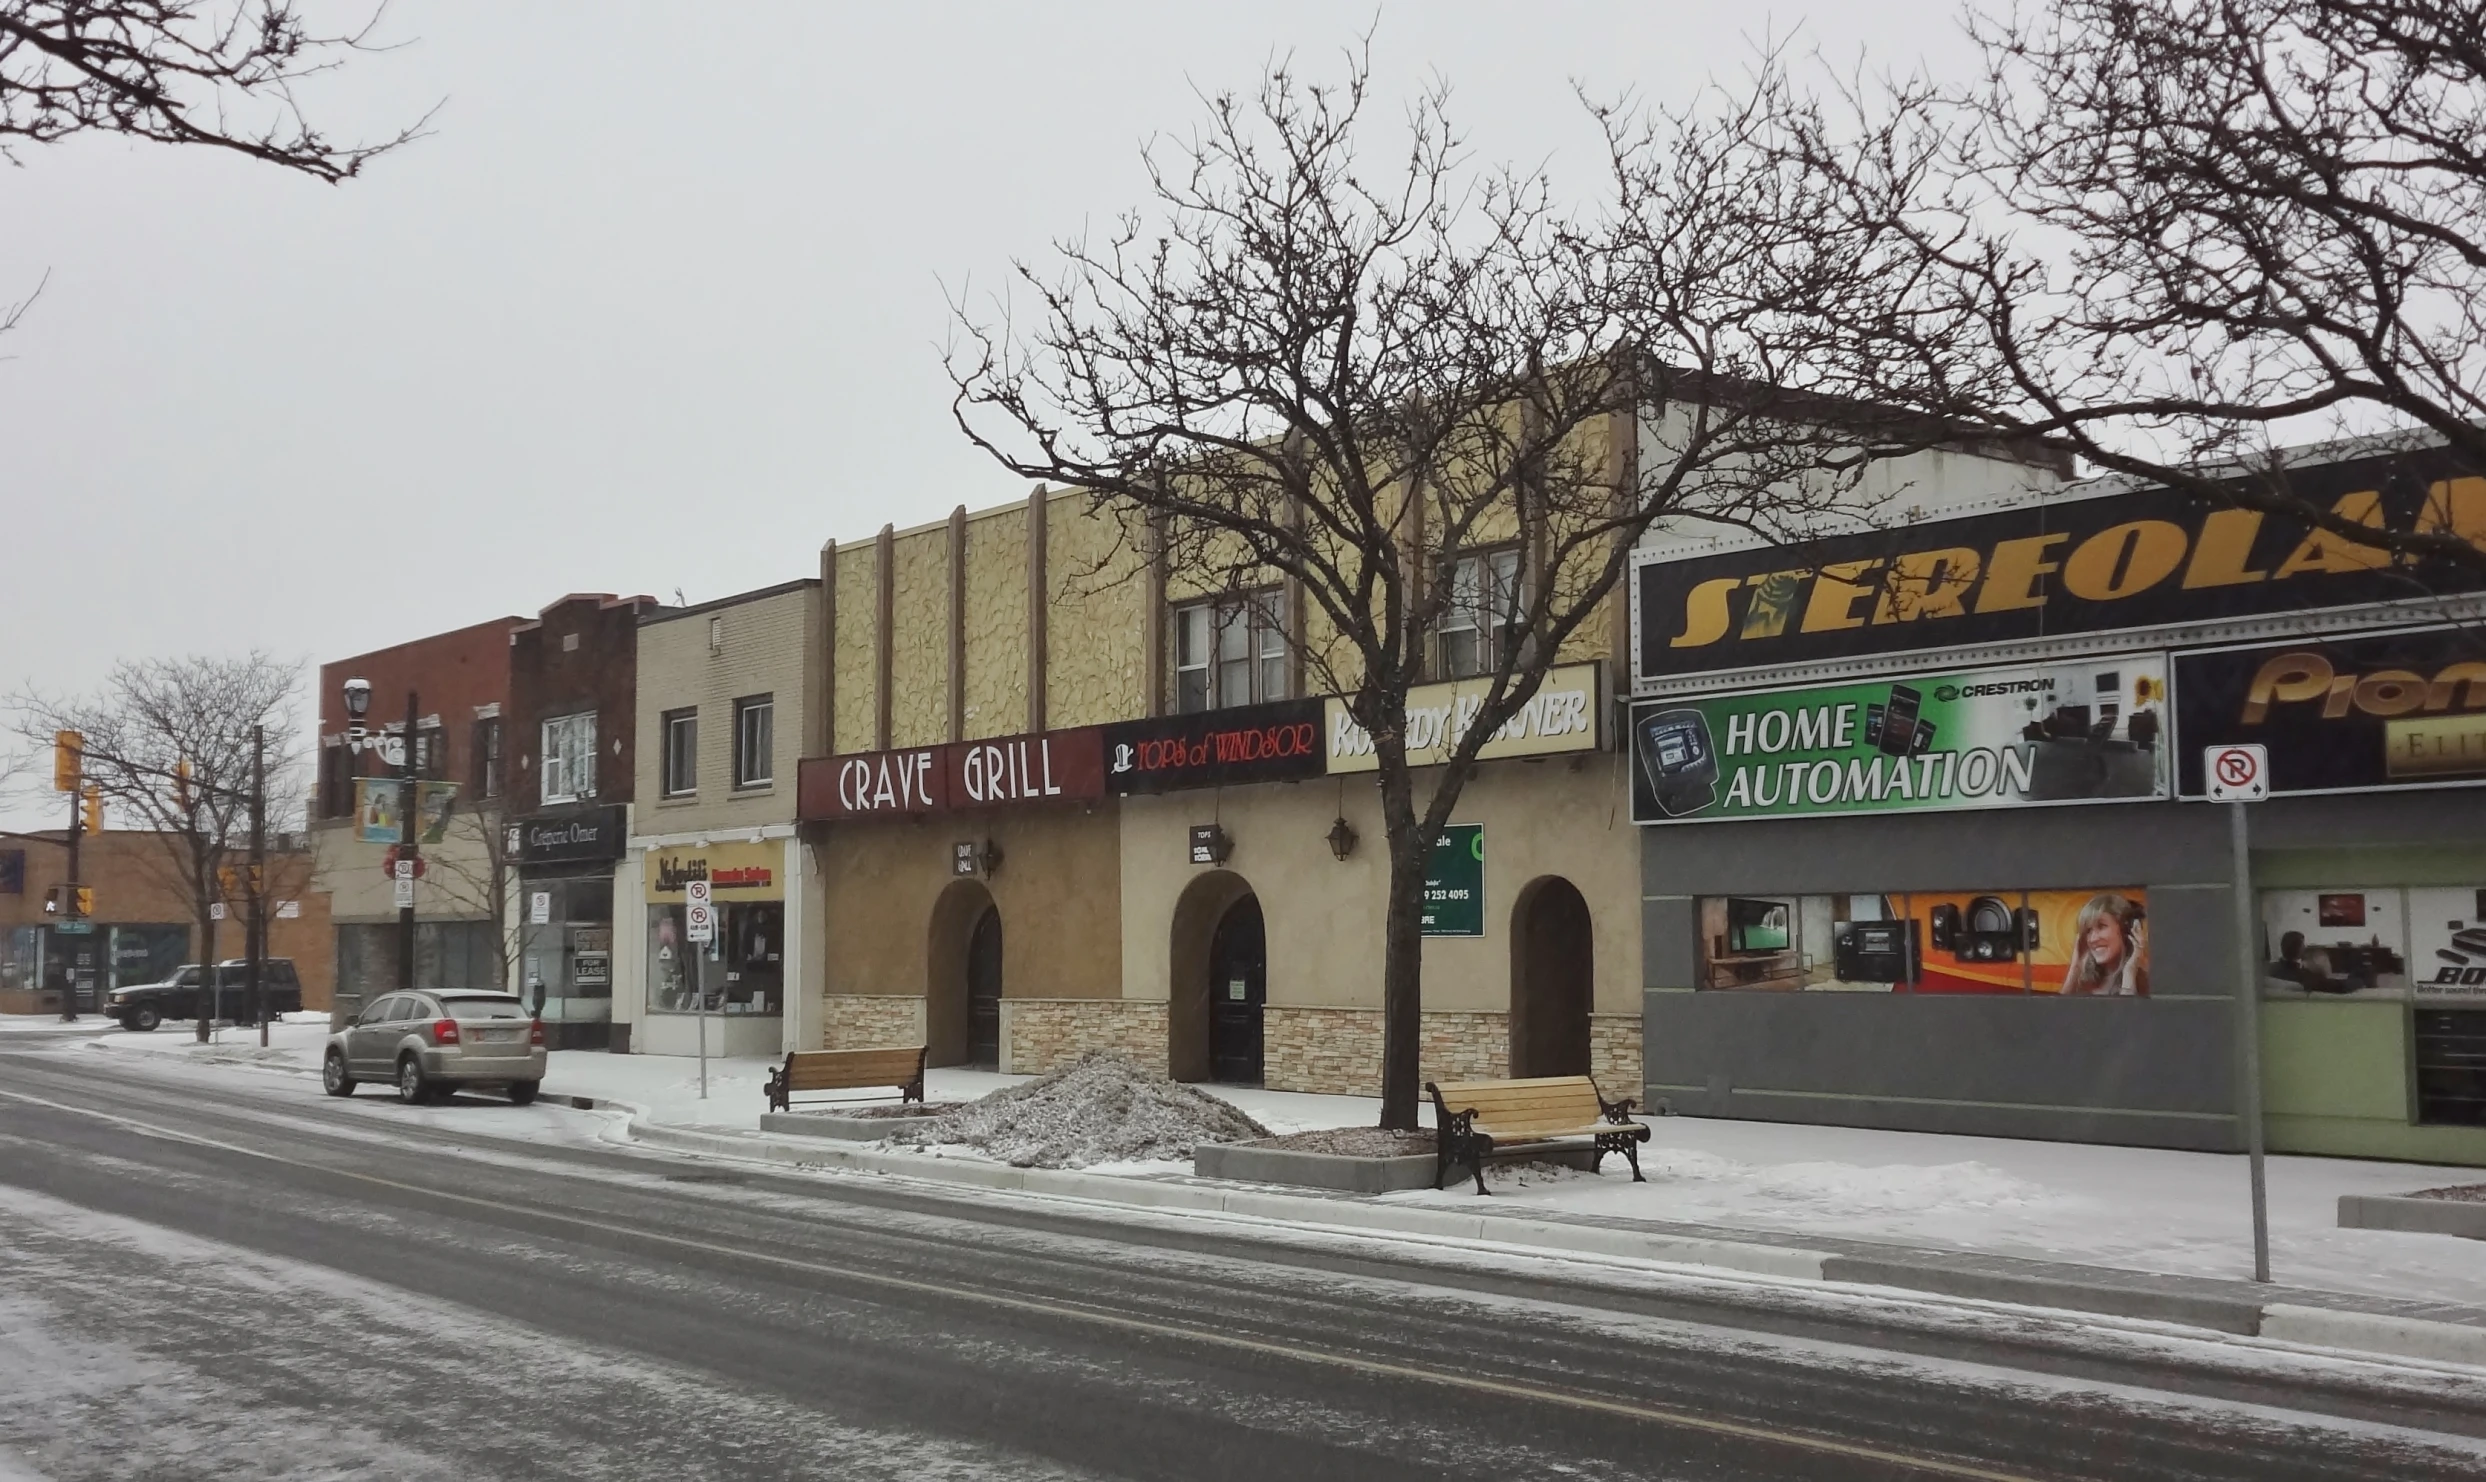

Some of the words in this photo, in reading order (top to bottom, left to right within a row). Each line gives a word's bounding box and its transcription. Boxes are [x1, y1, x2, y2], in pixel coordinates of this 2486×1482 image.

[1961, 678, 2056, 698] CRESTRON
[1333, 707, 1451, 757] KOEDY
[1725, 703, 1858, 756] HOME
[1137, 735, 1187, 771] TOPS
[1190, 731, 1214, 766] of
[1215, 723, 1314, 764] WINDSOR
[839, 752, 933, 811] CRAVE
[963, 739, 1061, 801] GRILL
[1723, 745, 2037, 808] AUTOMATION
[1435, 835, 1451, 847] ale
[1431, 890, 1447, 900] 252
[1448, 889, 1469, 900] 4095
[576, 966, 606, 976] LEASE
[582, 959, 600, 967] FOR
